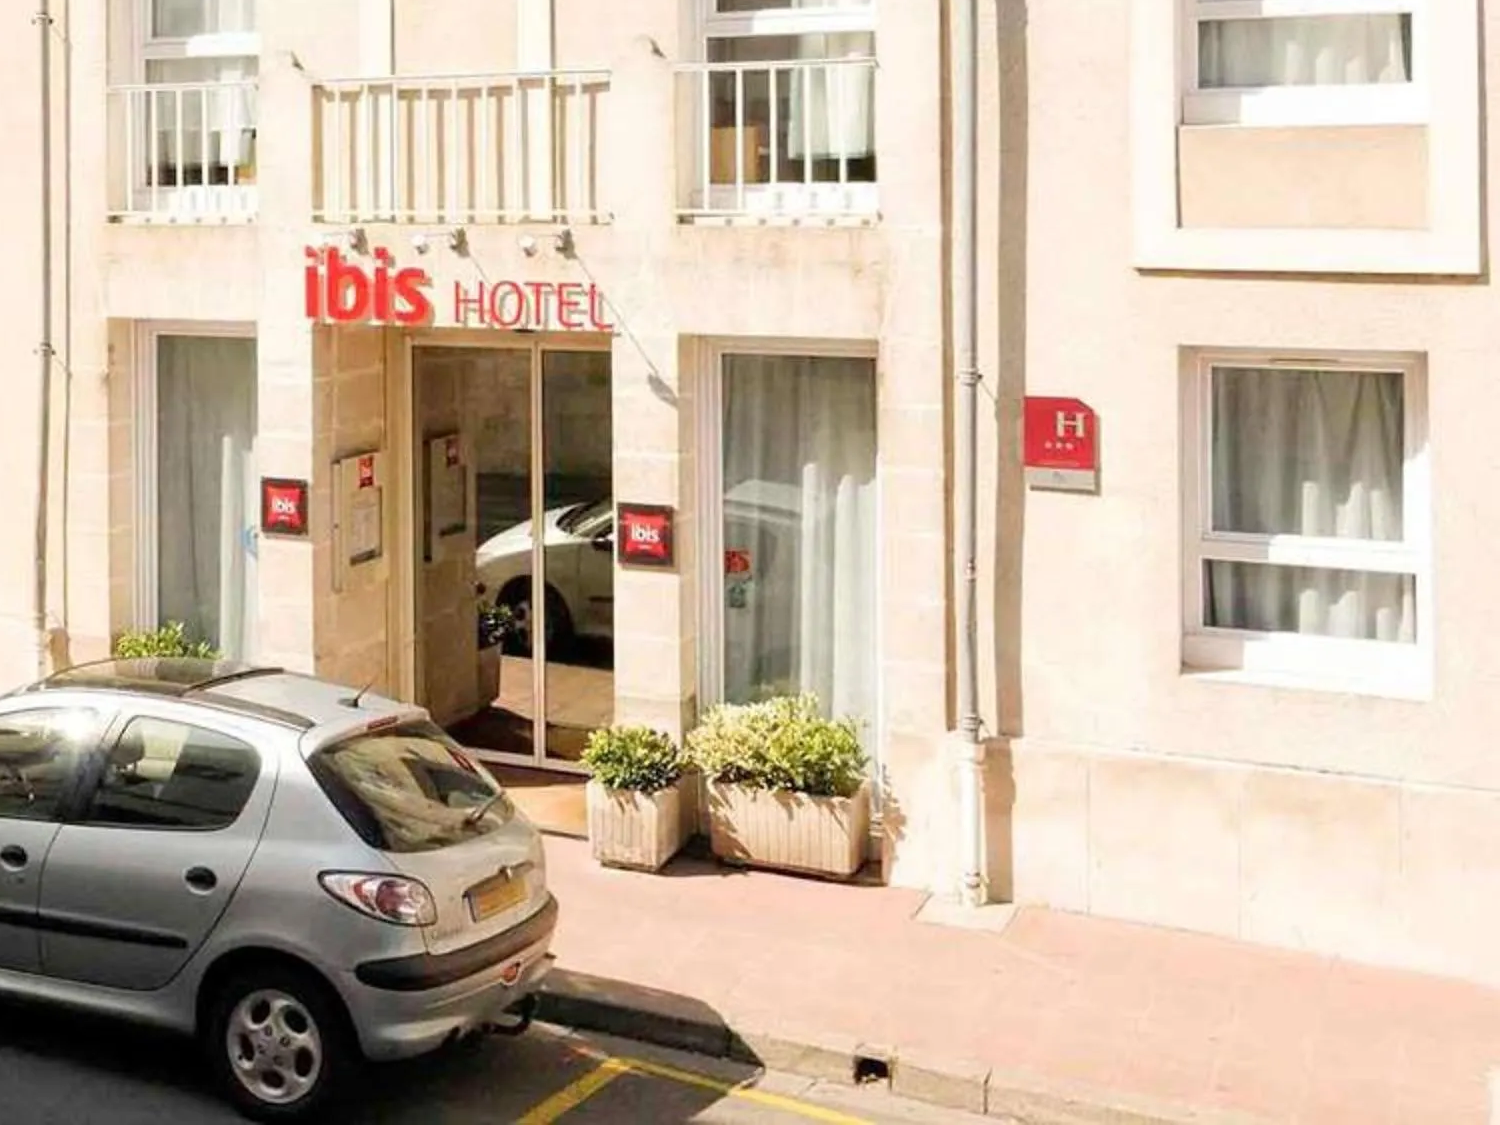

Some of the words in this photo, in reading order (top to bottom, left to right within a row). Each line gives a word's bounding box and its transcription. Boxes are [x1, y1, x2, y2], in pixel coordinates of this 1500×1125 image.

[304, 245, 430, 323] ibis
[453, 280, 614, 329] HOTEL
[1056, 411, 1084, 437] H
[271, 497, 297, 514] ibis
[631, 523, 660, 543] ibis
